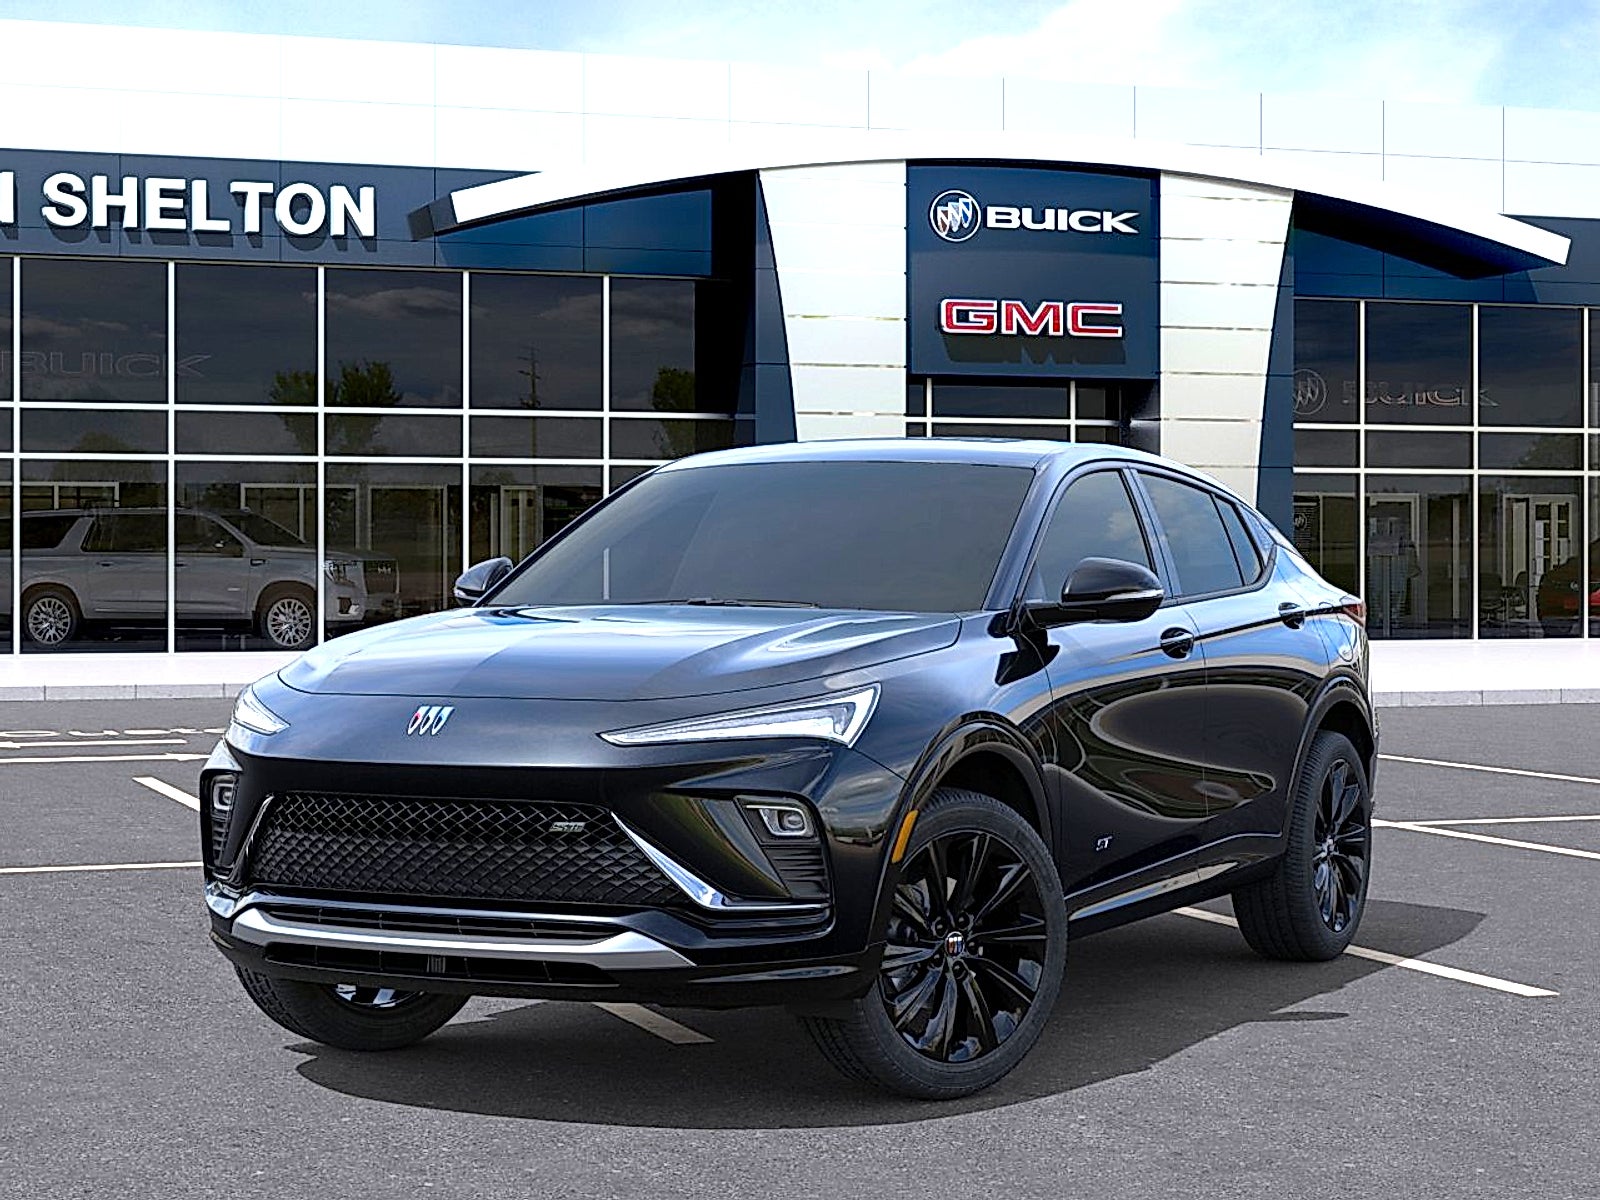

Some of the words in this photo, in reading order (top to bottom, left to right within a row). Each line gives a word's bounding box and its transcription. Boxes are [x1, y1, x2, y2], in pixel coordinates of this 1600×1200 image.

[41, 172, 375, 237] SHELTON
[986, 205, 1141, 235] BUICK
[940, 298, 1123, 338] GMC
[0, 351, 212, 378] BUICK
